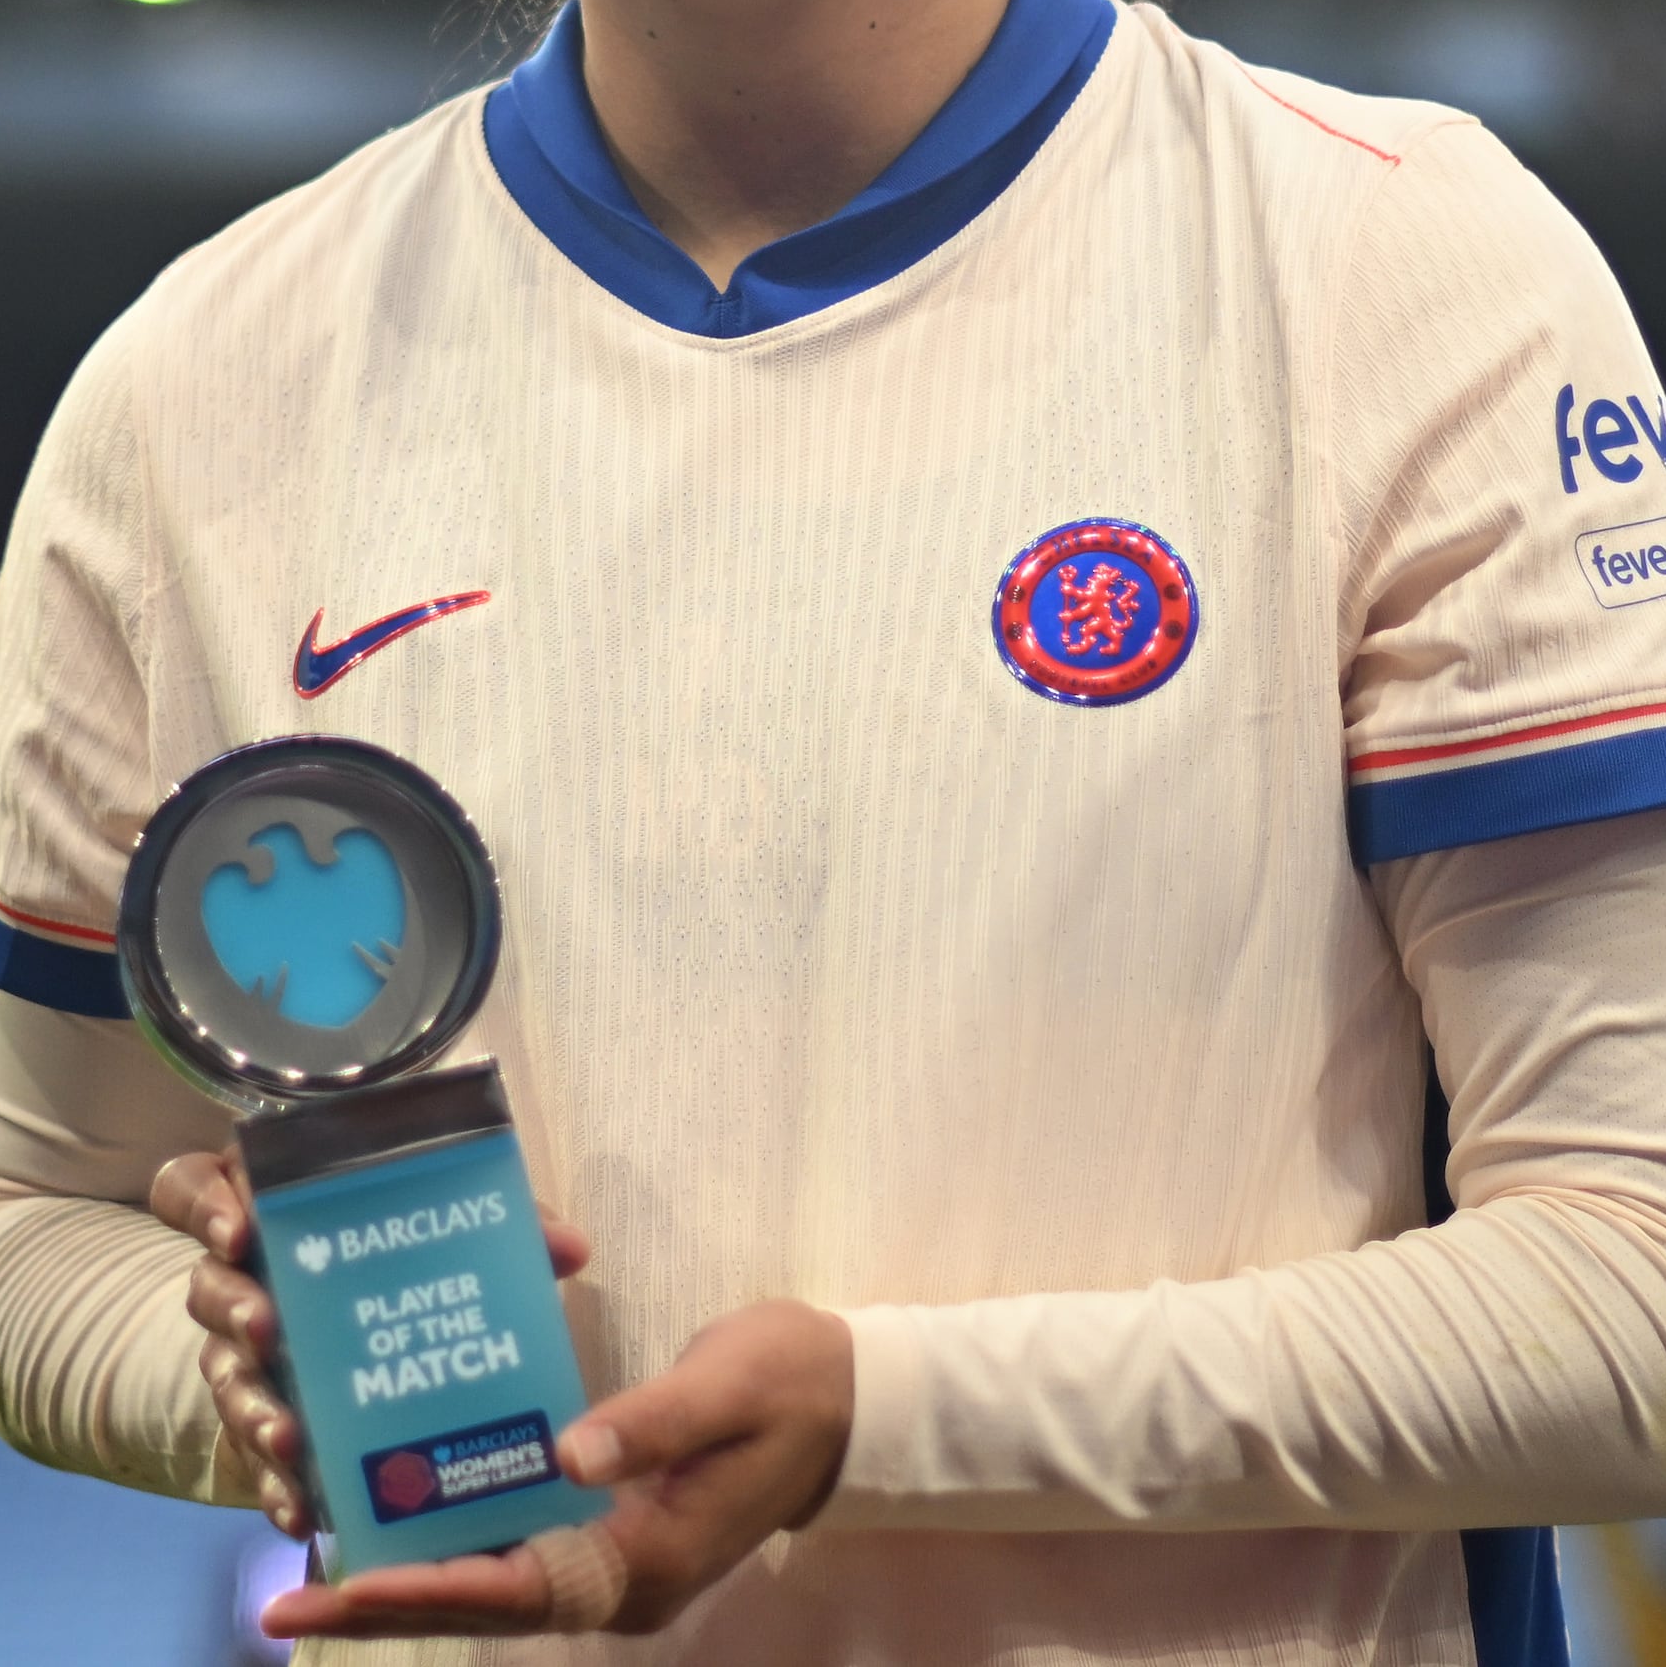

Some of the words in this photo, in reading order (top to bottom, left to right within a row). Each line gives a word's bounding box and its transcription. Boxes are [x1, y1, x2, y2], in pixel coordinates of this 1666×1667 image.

[338, 1191, 507, 1261] BARCLAYS
[355, 1272, 482, 1327] PLAYER
[367, 1326, 410, 1357] OF
[417, 1305, 487, 1343] THE
[351, 1330, 521, 1406] MATCH
[436, 1441, 544, 1482] WOMEN'S
[455, 1424, 539, 1457] BARCLAYS
[442, 1474, 491, 1497] SUPER
[492, 1459, 548, 1485] LEAGUE
